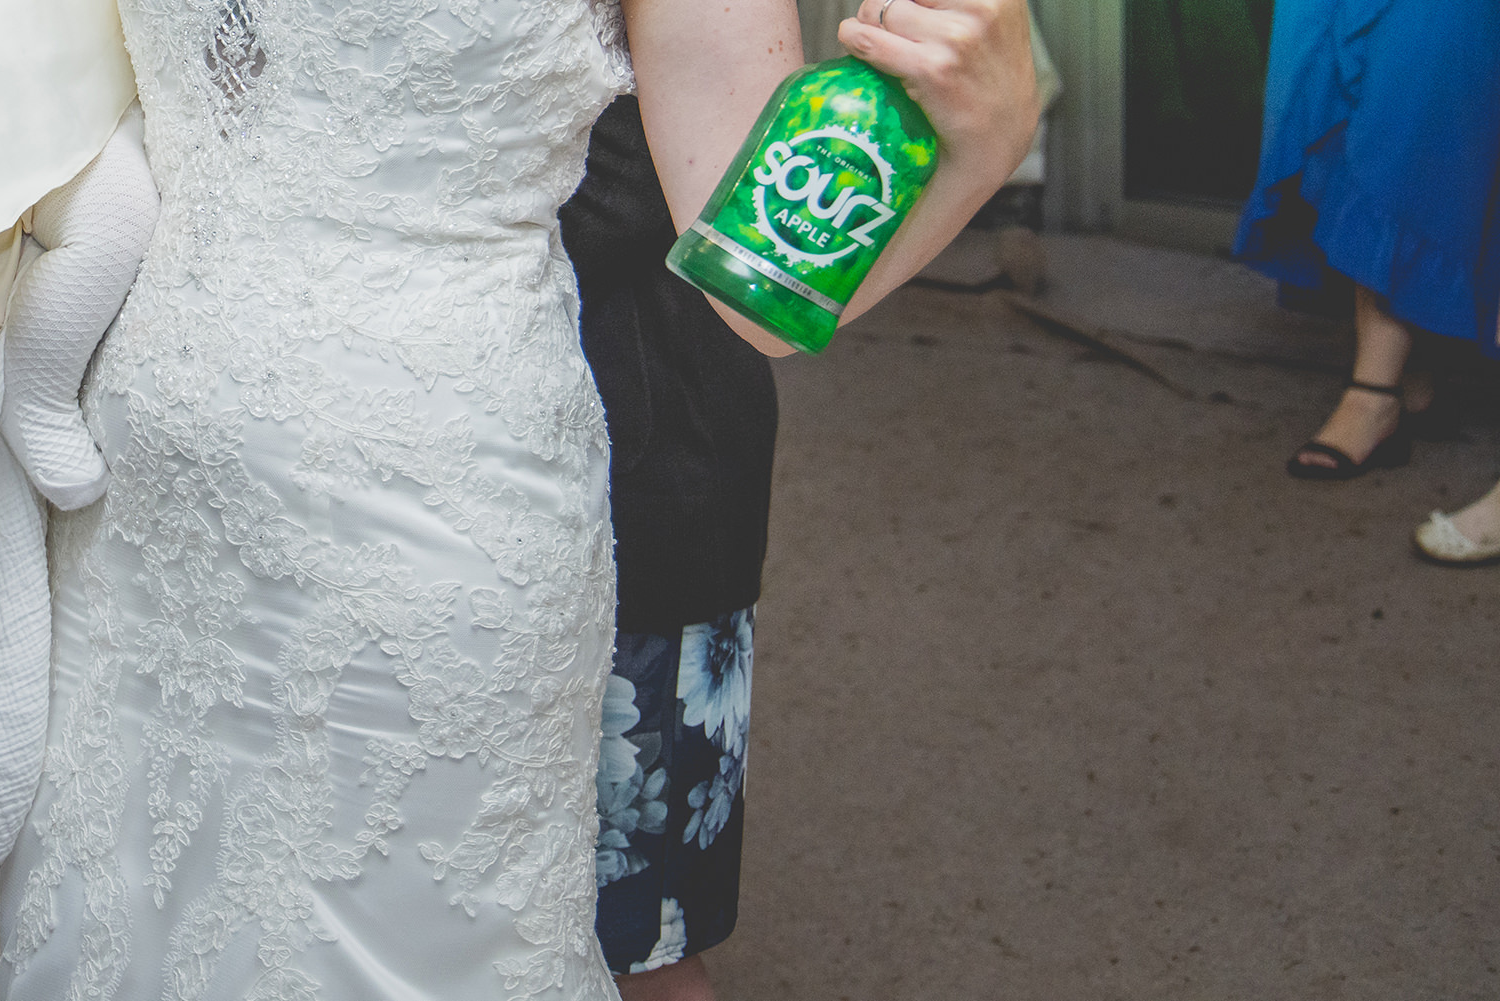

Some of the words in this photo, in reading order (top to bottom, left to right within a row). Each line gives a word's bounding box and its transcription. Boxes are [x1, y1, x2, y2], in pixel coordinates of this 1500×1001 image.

[815, 145, 831, 158] THE
[834, 157, 873, 183] ORIGINAL
[774, 208, 831, 248] APPLE
